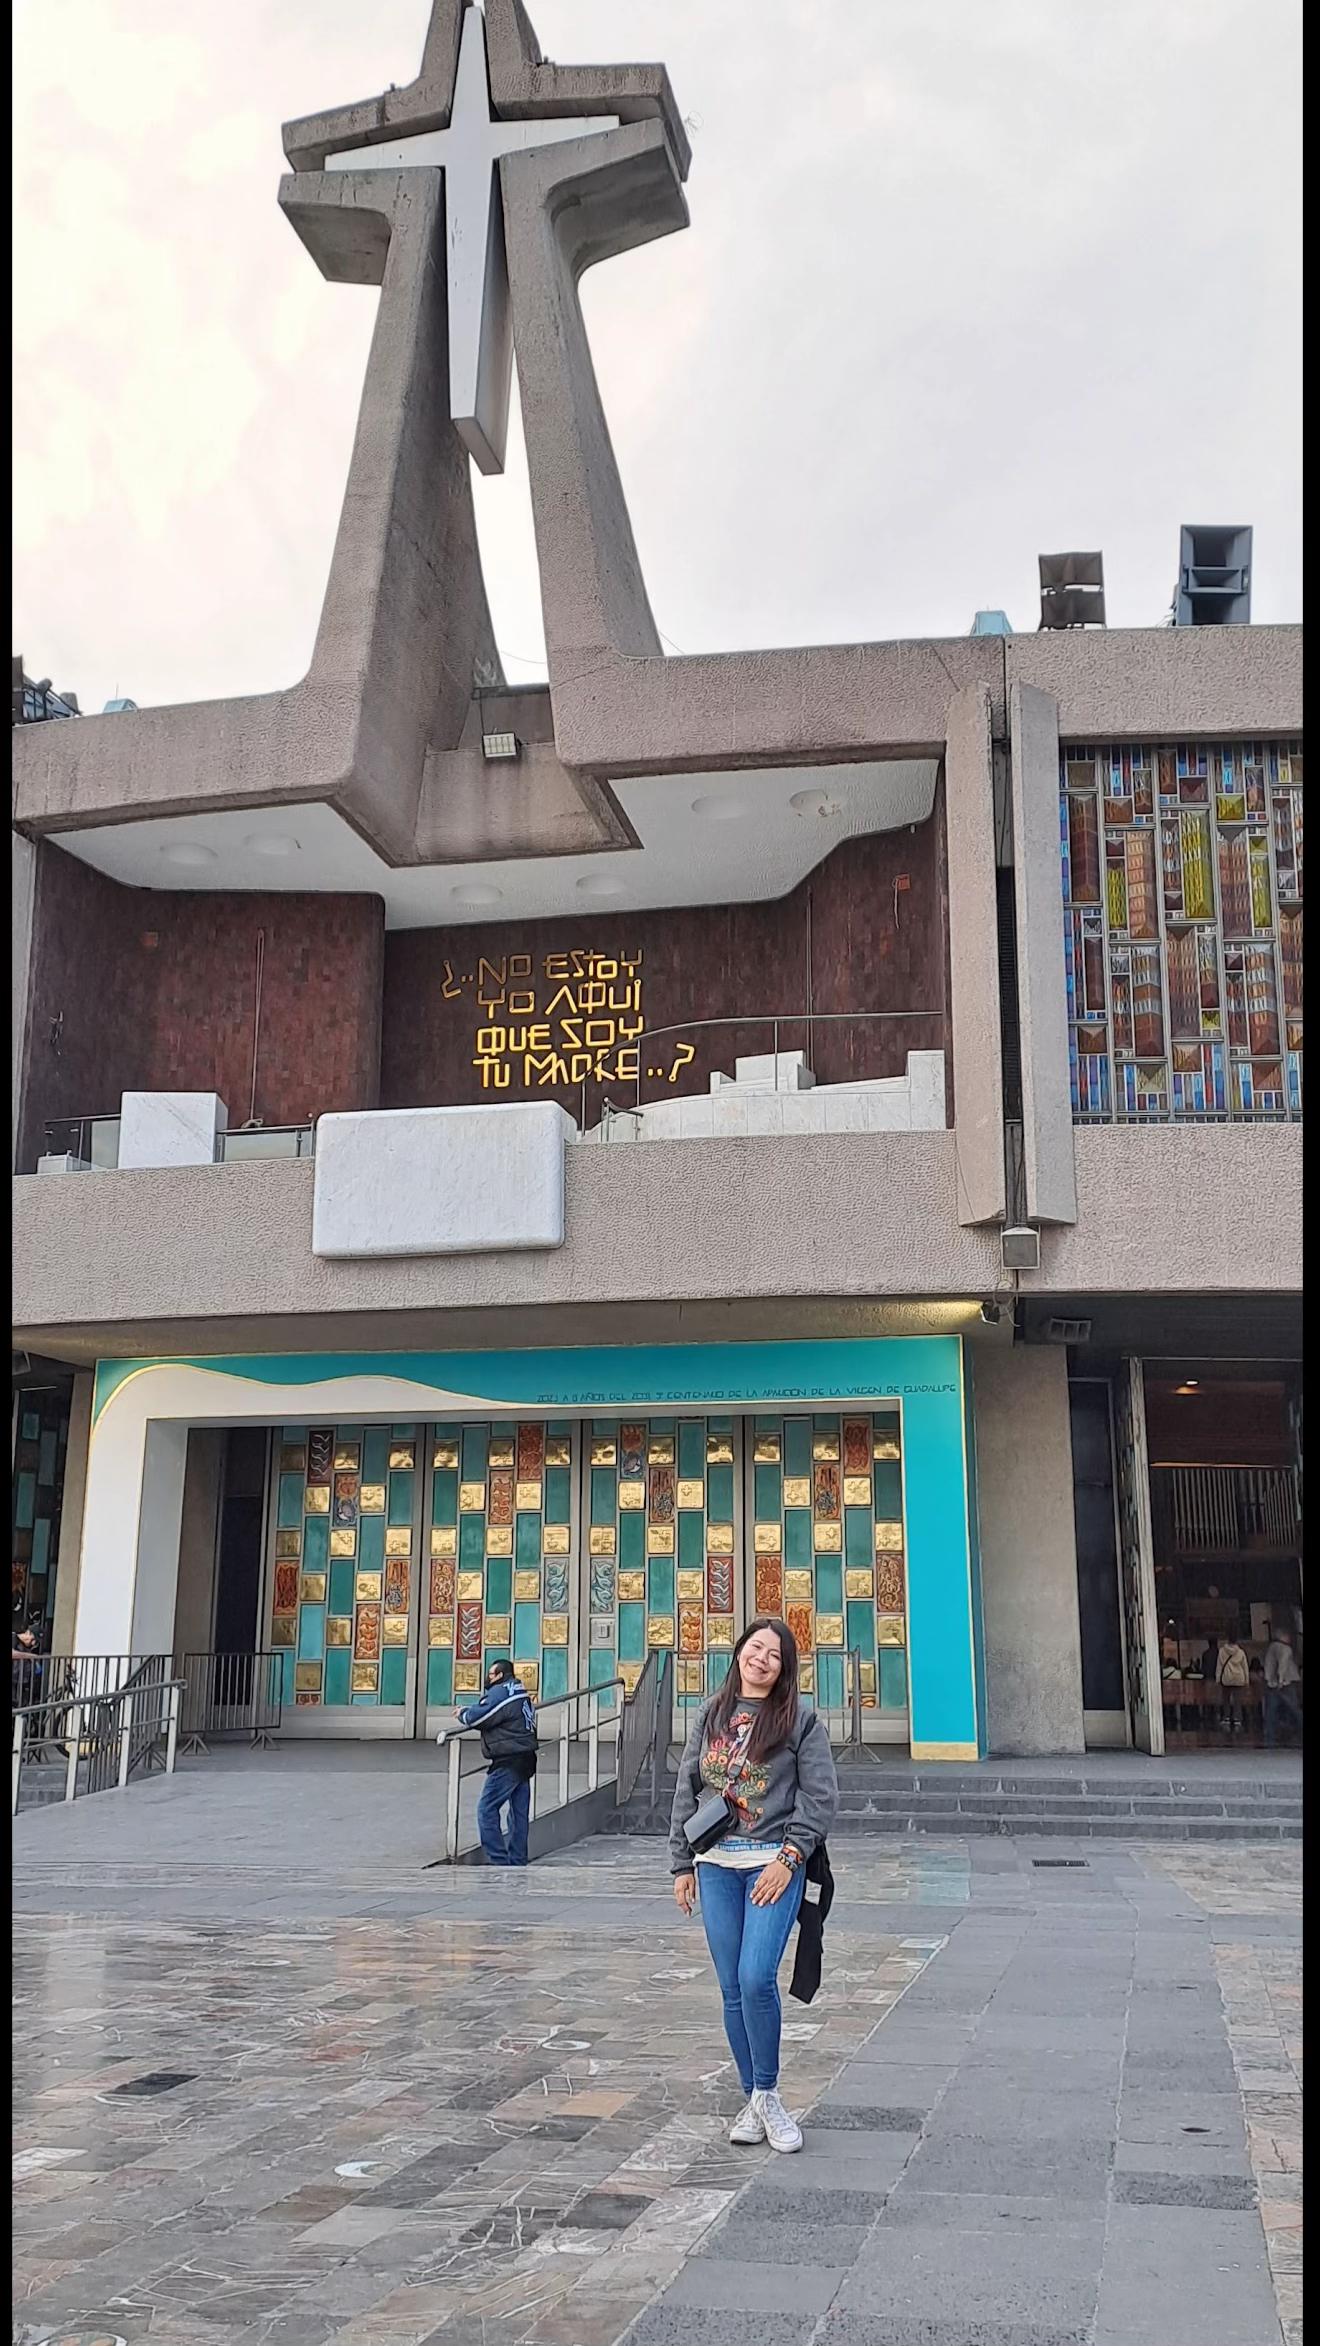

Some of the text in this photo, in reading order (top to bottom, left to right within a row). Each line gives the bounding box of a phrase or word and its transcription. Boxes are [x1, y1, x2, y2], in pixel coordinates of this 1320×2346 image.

[477, 988, 534, 1019] YO
[476, 1016, 644, 1056] QUE SOY
[472, 1055, 510, 1088] TU
